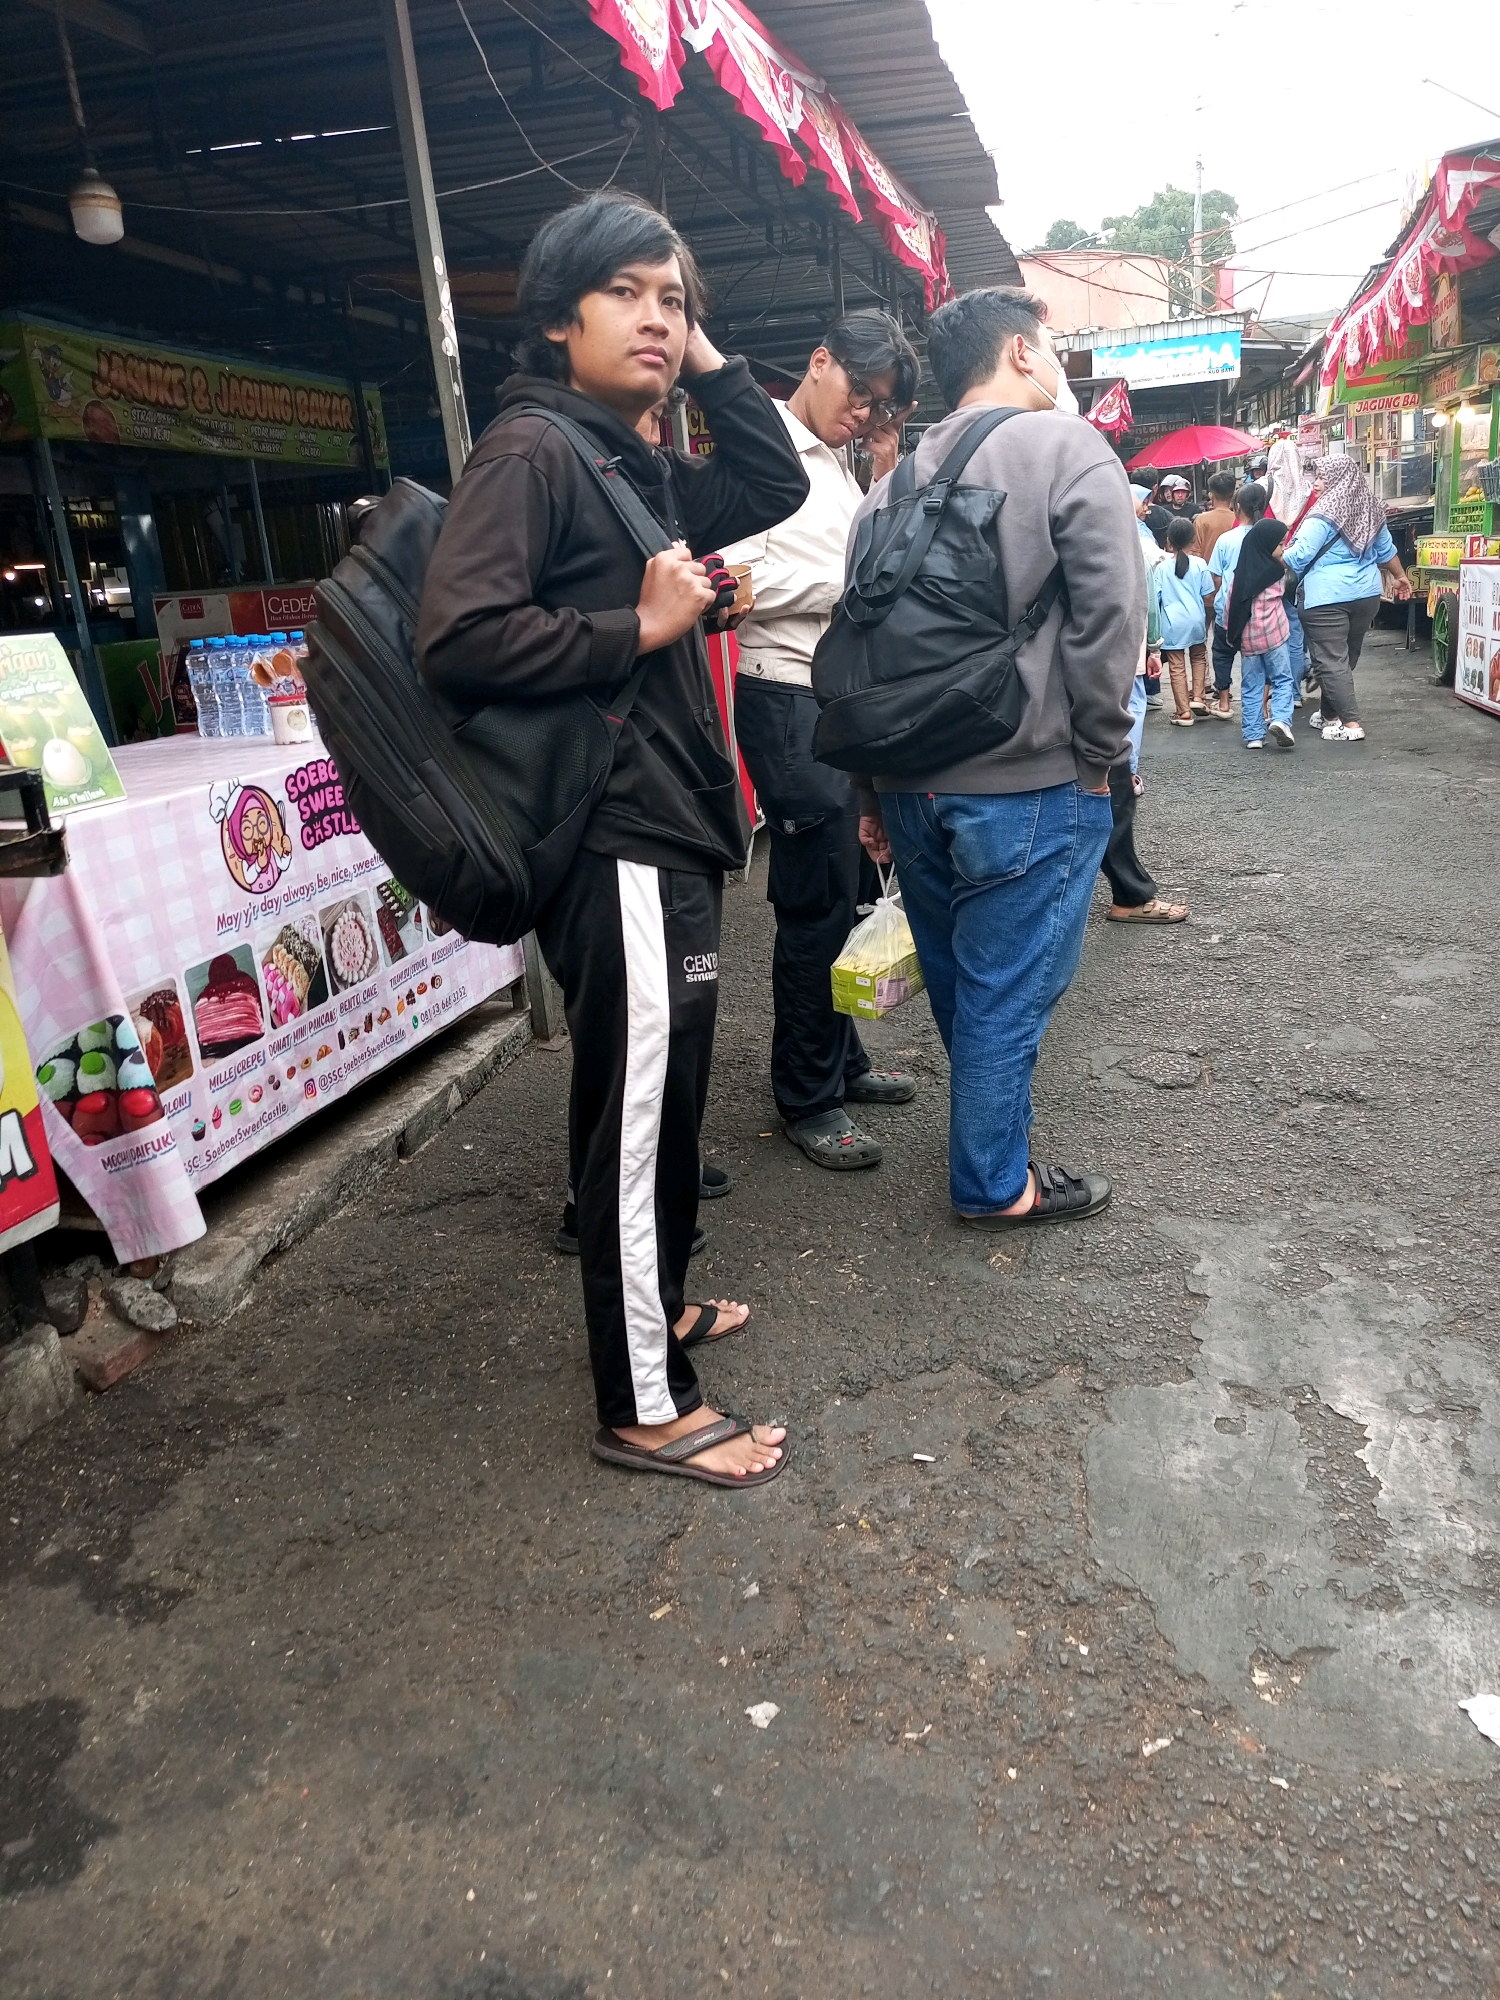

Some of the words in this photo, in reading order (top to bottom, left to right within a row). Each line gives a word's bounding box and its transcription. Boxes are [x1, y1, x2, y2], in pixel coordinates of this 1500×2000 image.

[1379, 341, 1424, 362] OILET
[92, 348, 188, 410] JASUKE
[190, 366, 213, 414] &
[215, 371, 294, 426] JAGUNG
[294, 386, 356, 433] BAKAR
[1355, 396, 1401, 413] JAGUNG
[1121, 424, 1159, 437] entol
[268, 593, 317, 614] CEDEA
[0, 649, 56, 681] rigan
[286, 758, 339, 801] SOEBO
[299, 784, 345, 821] SWEE
[217, 912, 241, 932] May
[260, 895, 283, 917] day
[282, 882, 317, 905] always
[316, 872, 331, 888] be
[340, 993, 361, 1014] BENTO
[362, 983, 379, 1001] CAKE
[268, 1034, 291, 1057] DONAT
[292, 1025, 307, 1043] MINI
[209, 1066, 234, 1091] MILLE
[236, 1053, 265, 1076] CREPE
[164, 1092, 189, 1116] OLONI
[101, 1150, 131, 1171] MOCHI
